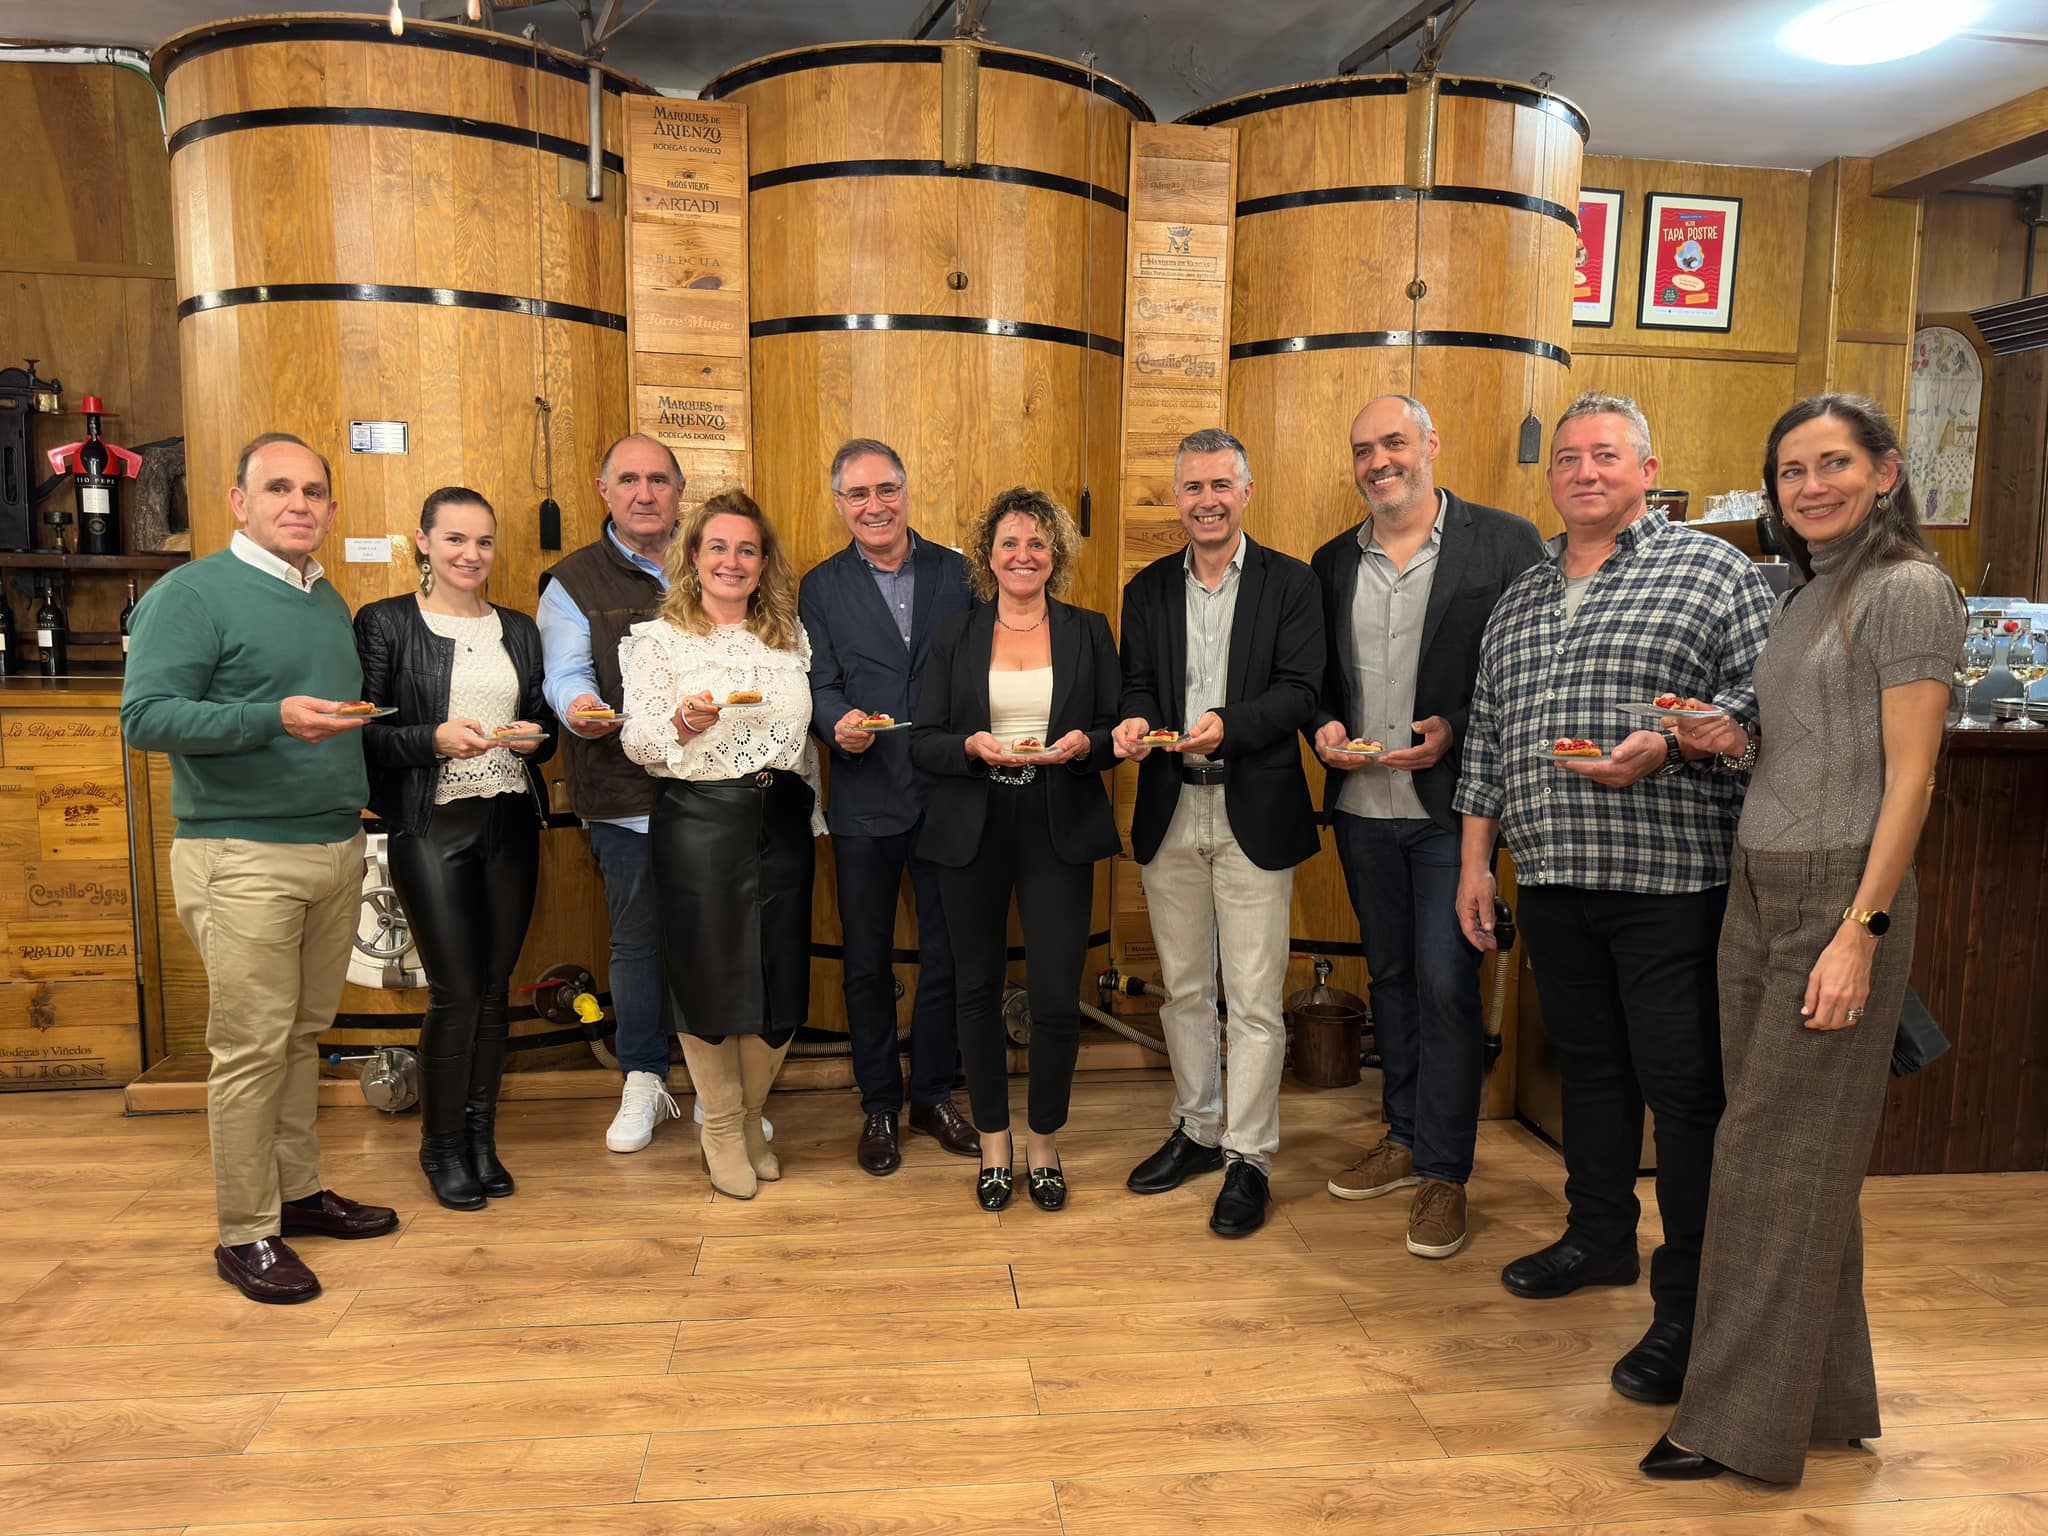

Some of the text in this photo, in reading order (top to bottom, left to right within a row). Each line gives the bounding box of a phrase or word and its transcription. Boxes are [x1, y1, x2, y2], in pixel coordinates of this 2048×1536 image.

[653, 106, 720, 124] MARQUES DE
[653, 120, 722, 144] ARIENZO
[653, 143, 722, 155] BODEGAS DOMECQ
[666, 180, 710, 191] PAGOS VIEJOS
[656, 197, 720, 213] ARTADI
[1663, 225, 1718, 242] TAPA POSTRE
[643, 313, 735, 331] Torre Muga
[657, 396, 713, 412] MARQUES
[657, 410, 726, 431] ARIENZO
[658, 431, 726, 441] BODEGAS DOMECQ
[3, 722, 23, 737] La
[28, 722, 66, 740] Rioja
[67, 722, 96, 737] Alta
[39, 791, 51, 809] La
[52, 783, 80, 799] Rioja
[83, 781, 107, 798] Alta
[29, 882, 128, 906] Castillo Ygay
[18, 943, 128, 961] PRADO ENEA
[0, 1047, 40, 1059] Bodegas
[42, 1049, 49, 1057] y
